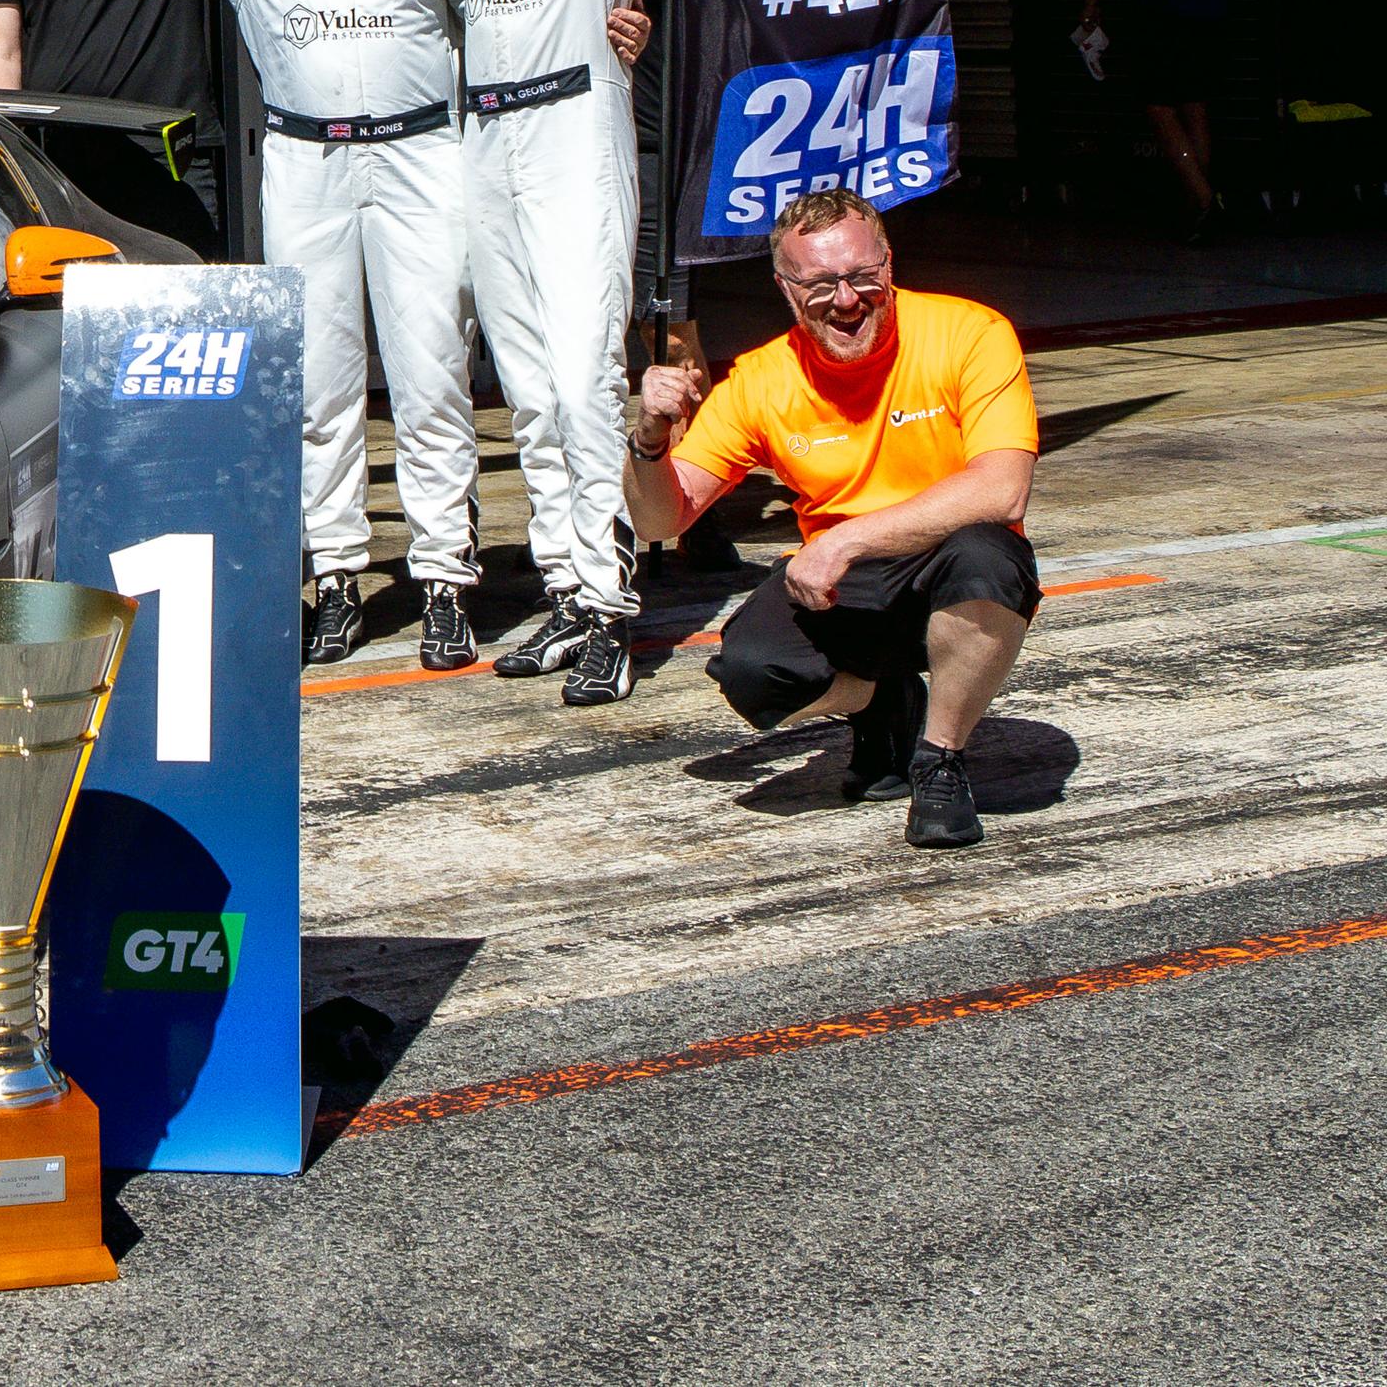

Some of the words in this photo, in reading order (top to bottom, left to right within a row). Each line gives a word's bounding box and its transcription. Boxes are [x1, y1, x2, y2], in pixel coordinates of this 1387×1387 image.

[317, 7, 394, 30] Vulcan
[322, 29, 395, 41] Fasteners
[503, 93, 517, 104] M.
[517, 80, 560, 100] GEORGE
[732, 49, 942, 180] 24H
[359, 126, 371, 137] N.
[372, 122, 404, 136] JONES
[126, 331, 247, 376] 24H
[121, 376, 236, 396] SERIES
[107, 532, 216, 765] 1
[123, 926, 225, 976] GT4
